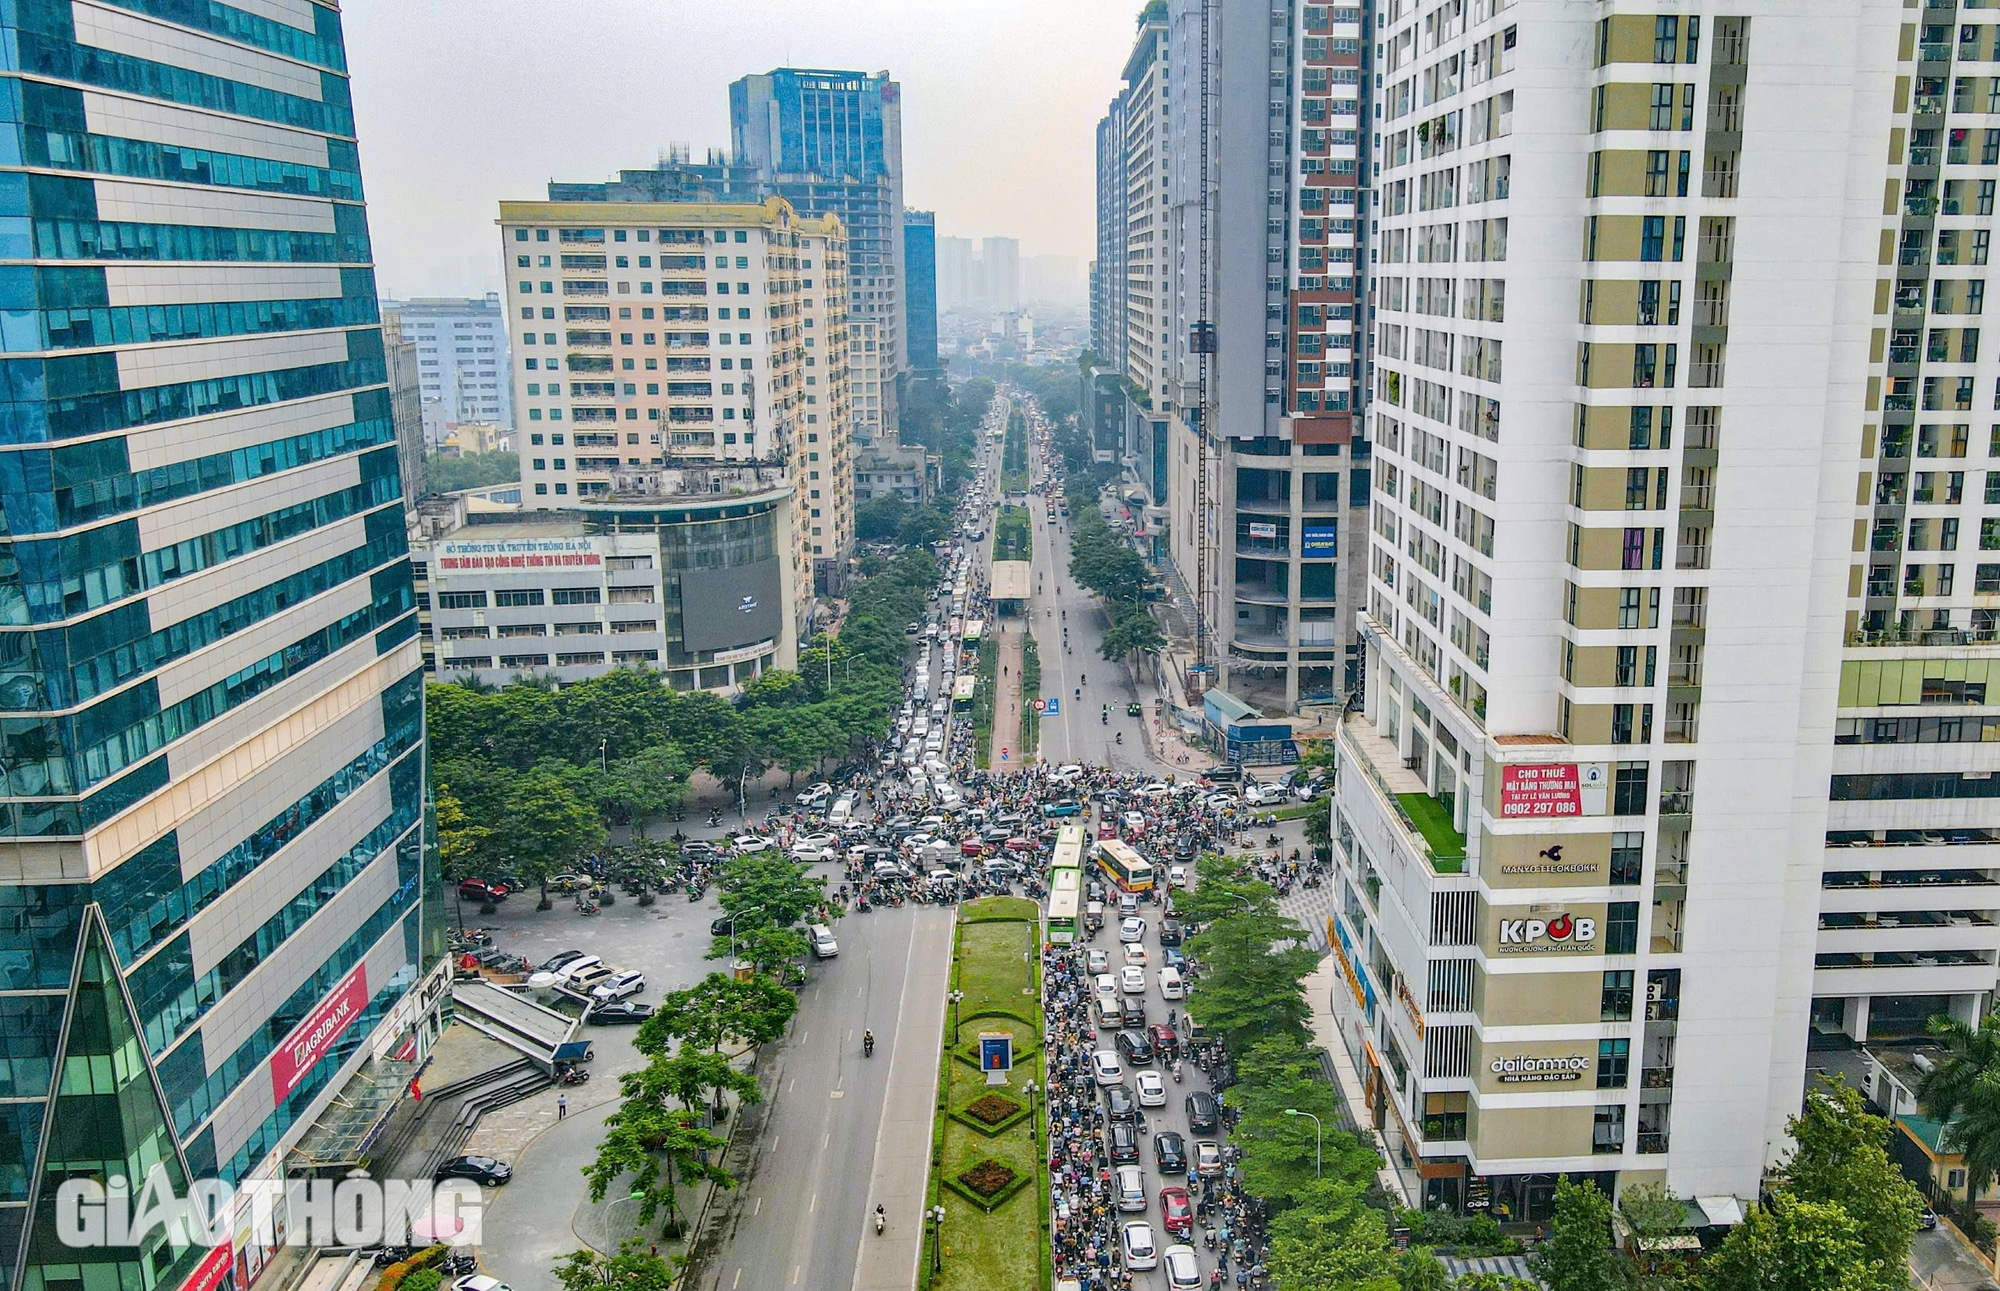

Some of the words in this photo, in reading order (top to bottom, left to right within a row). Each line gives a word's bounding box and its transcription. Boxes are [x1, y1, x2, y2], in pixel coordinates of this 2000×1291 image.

[1518, 769, 1539, 779] CHO
[1541, 767, 1566, 778] THUÊ
[1506, 780, 1520, 793] MẶT
[1521, 779, 1538, 790] BẰNG
[1564, 780, 1577, 792] MẠI
[1530, 792, 1537, 800] LÊ
[1504, 803, 1531, 815] 0902
[1533, 802, 1554, 814] 297
[1556, 801, 1576, 813] 086
[421, 965, 448, 1011] NEM
[305, 997, 351, 1056] AGRIBANK
